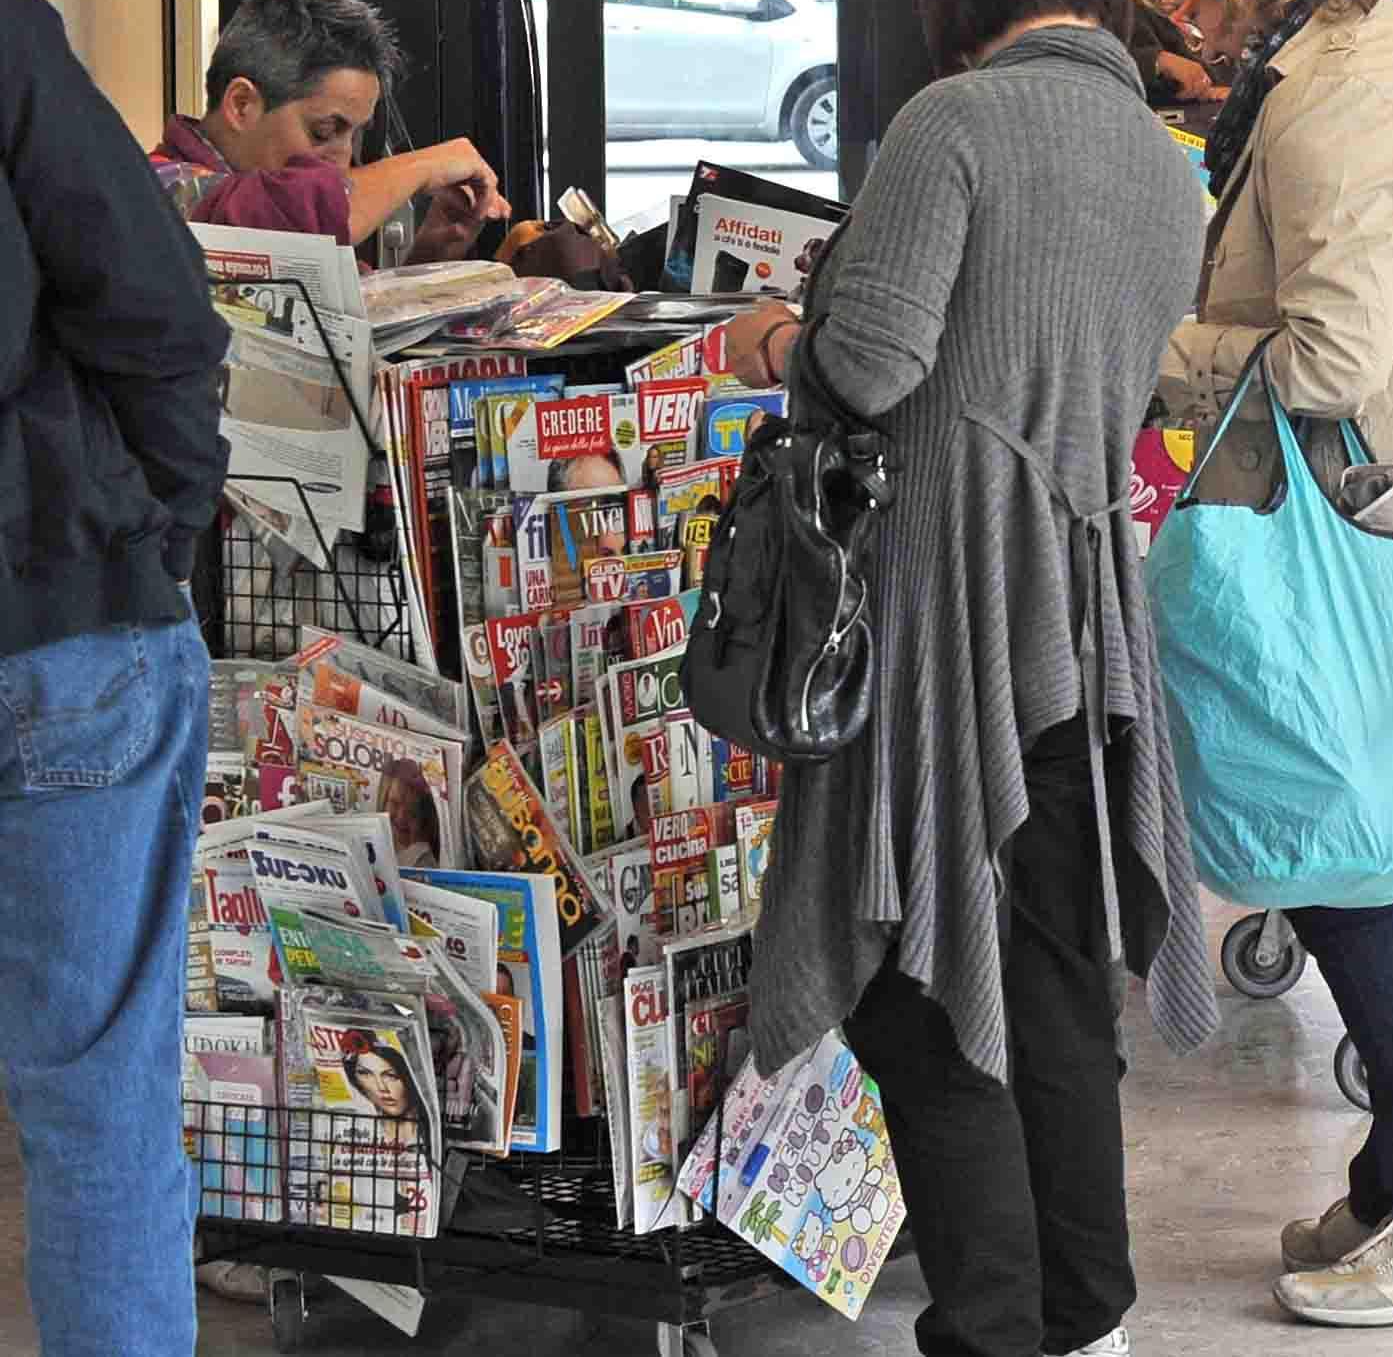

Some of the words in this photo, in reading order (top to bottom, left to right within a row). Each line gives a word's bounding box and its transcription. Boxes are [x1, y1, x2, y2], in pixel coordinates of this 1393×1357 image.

[542, 405, 604, 437] CREDERE
[590, 573, 625, 601] TV
[766, 1082, 826, 1194] HELLO
[783, 1095, 841, 1208] KITTY
